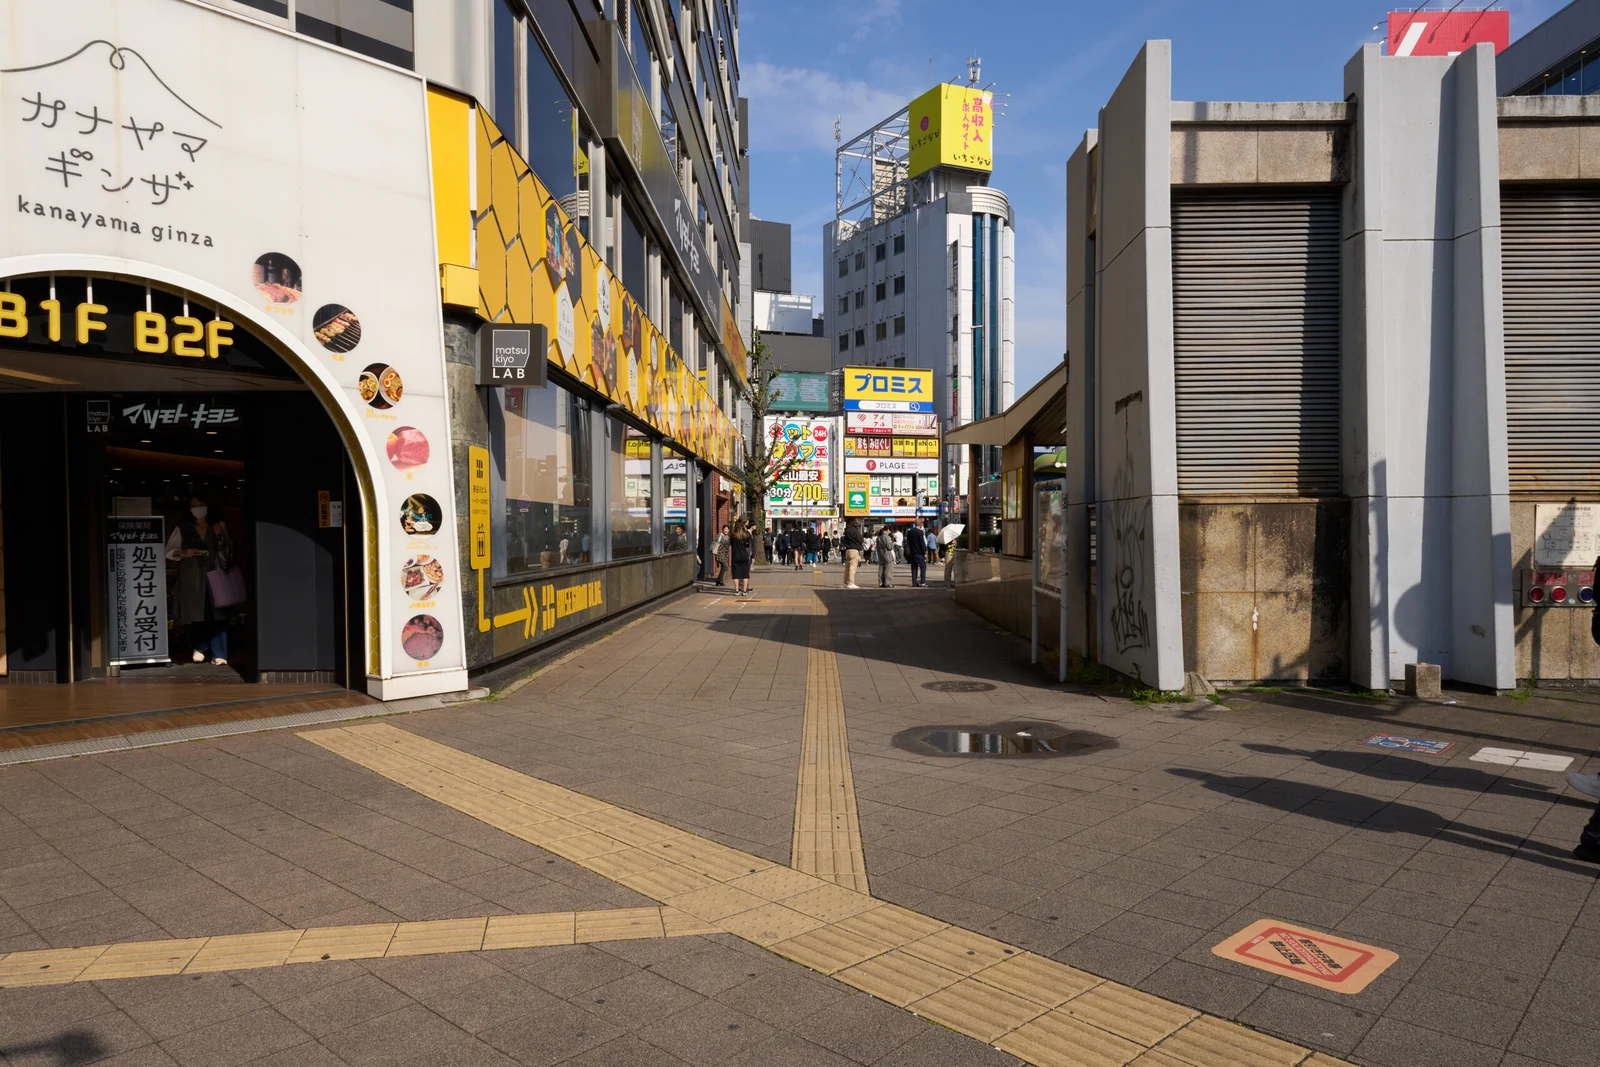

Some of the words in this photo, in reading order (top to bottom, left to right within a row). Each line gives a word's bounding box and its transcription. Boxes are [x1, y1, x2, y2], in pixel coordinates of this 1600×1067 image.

[21, 91, 208, 163] カナヤマ
[962, 102, 970, 150] 求人サイト
[971, 97, 984, 142] 高収入
[953, 153, 991, 166] いちごなび
[45, 147, 194, 205] ギンザ
[18, 194, 142, 236] kanayama
[151, 223, 214, 248] ginza
[0, 292, 108, 344] B1F
[133, 309, 235, 359] B2F
[495, 345, 527, 355] matsu
[495, 353, 515, 367] kiyo
[492, 367, 526, 379] LAB
[854, 373, 923, 394] プロミス
[87, 425, 108, 433] LAB
[814, 430, 827, 438] 24H
[784, 441, 828, 459] カフェ
[132, 545, 159, 653] 処方せん受付
[1313, 961, 1333, 976] ZONE
